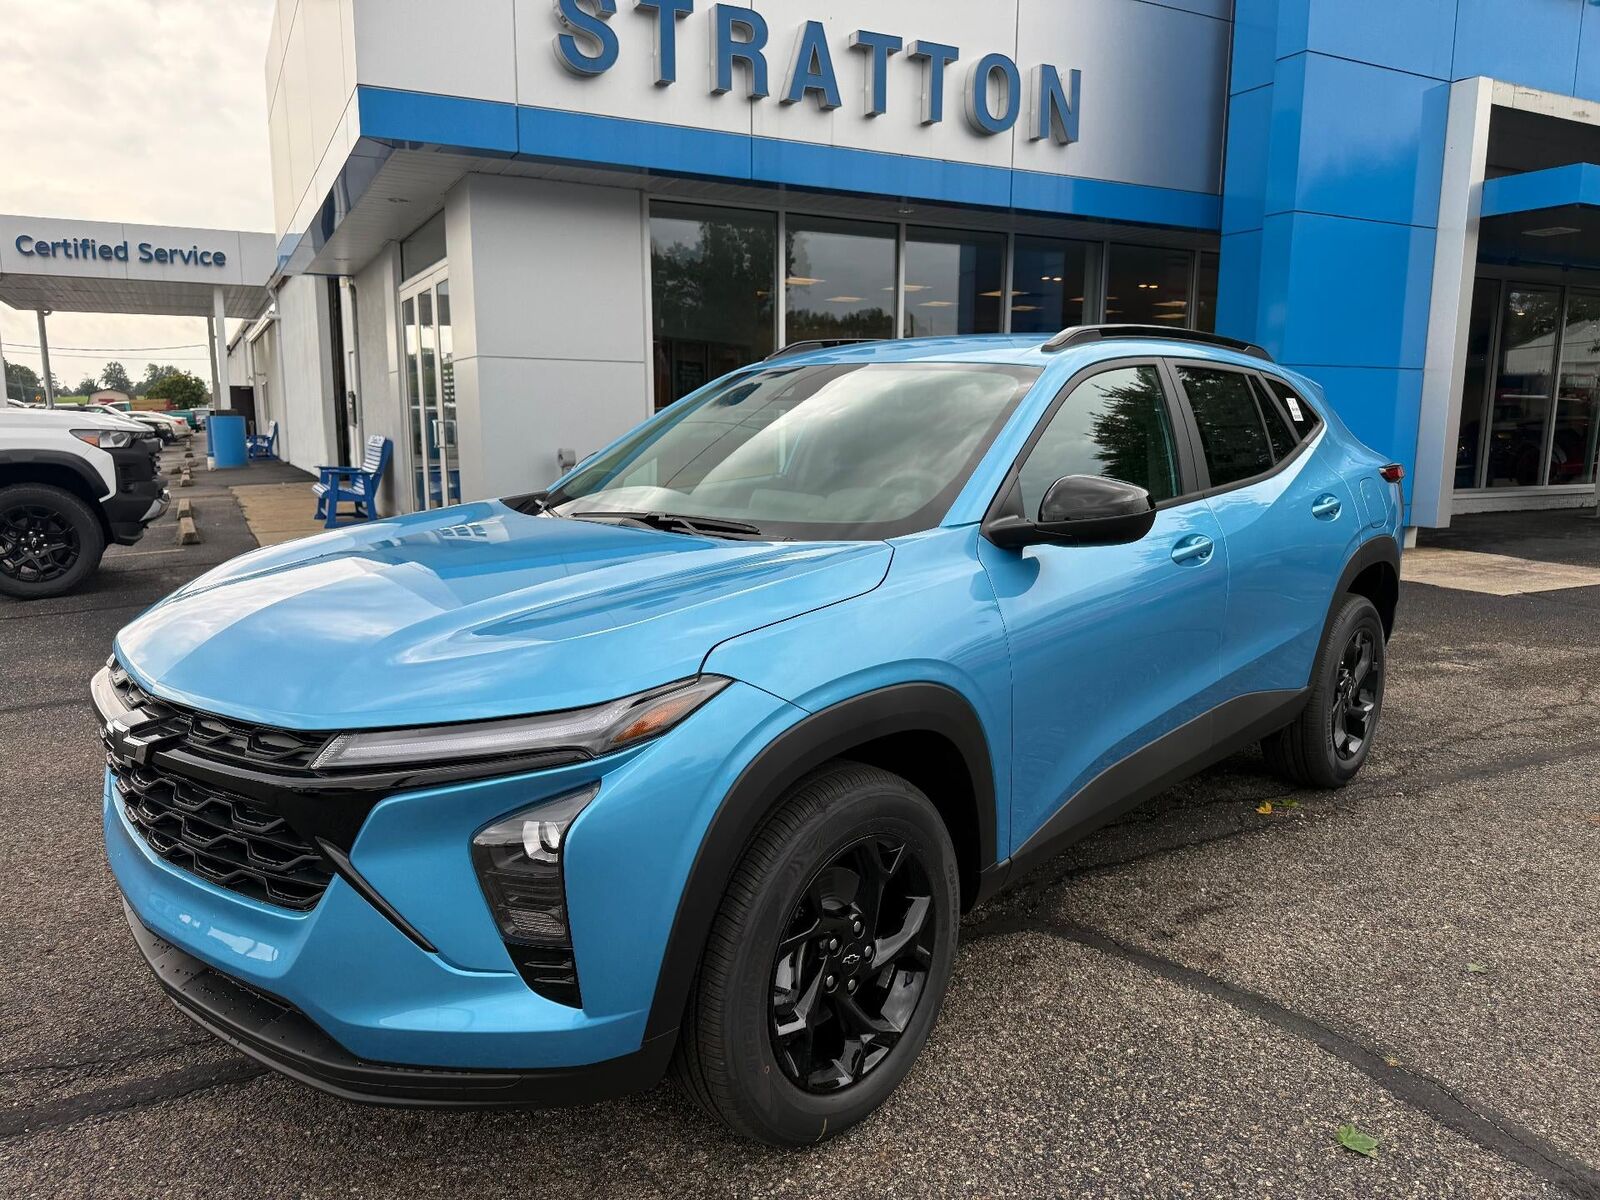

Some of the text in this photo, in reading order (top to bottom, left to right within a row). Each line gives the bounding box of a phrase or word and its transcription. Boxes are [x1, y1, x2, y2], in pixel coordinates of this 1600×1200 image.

[553, 0, 1081, 144] STRATTON
[15, 235, 226, 267] Certified Service
